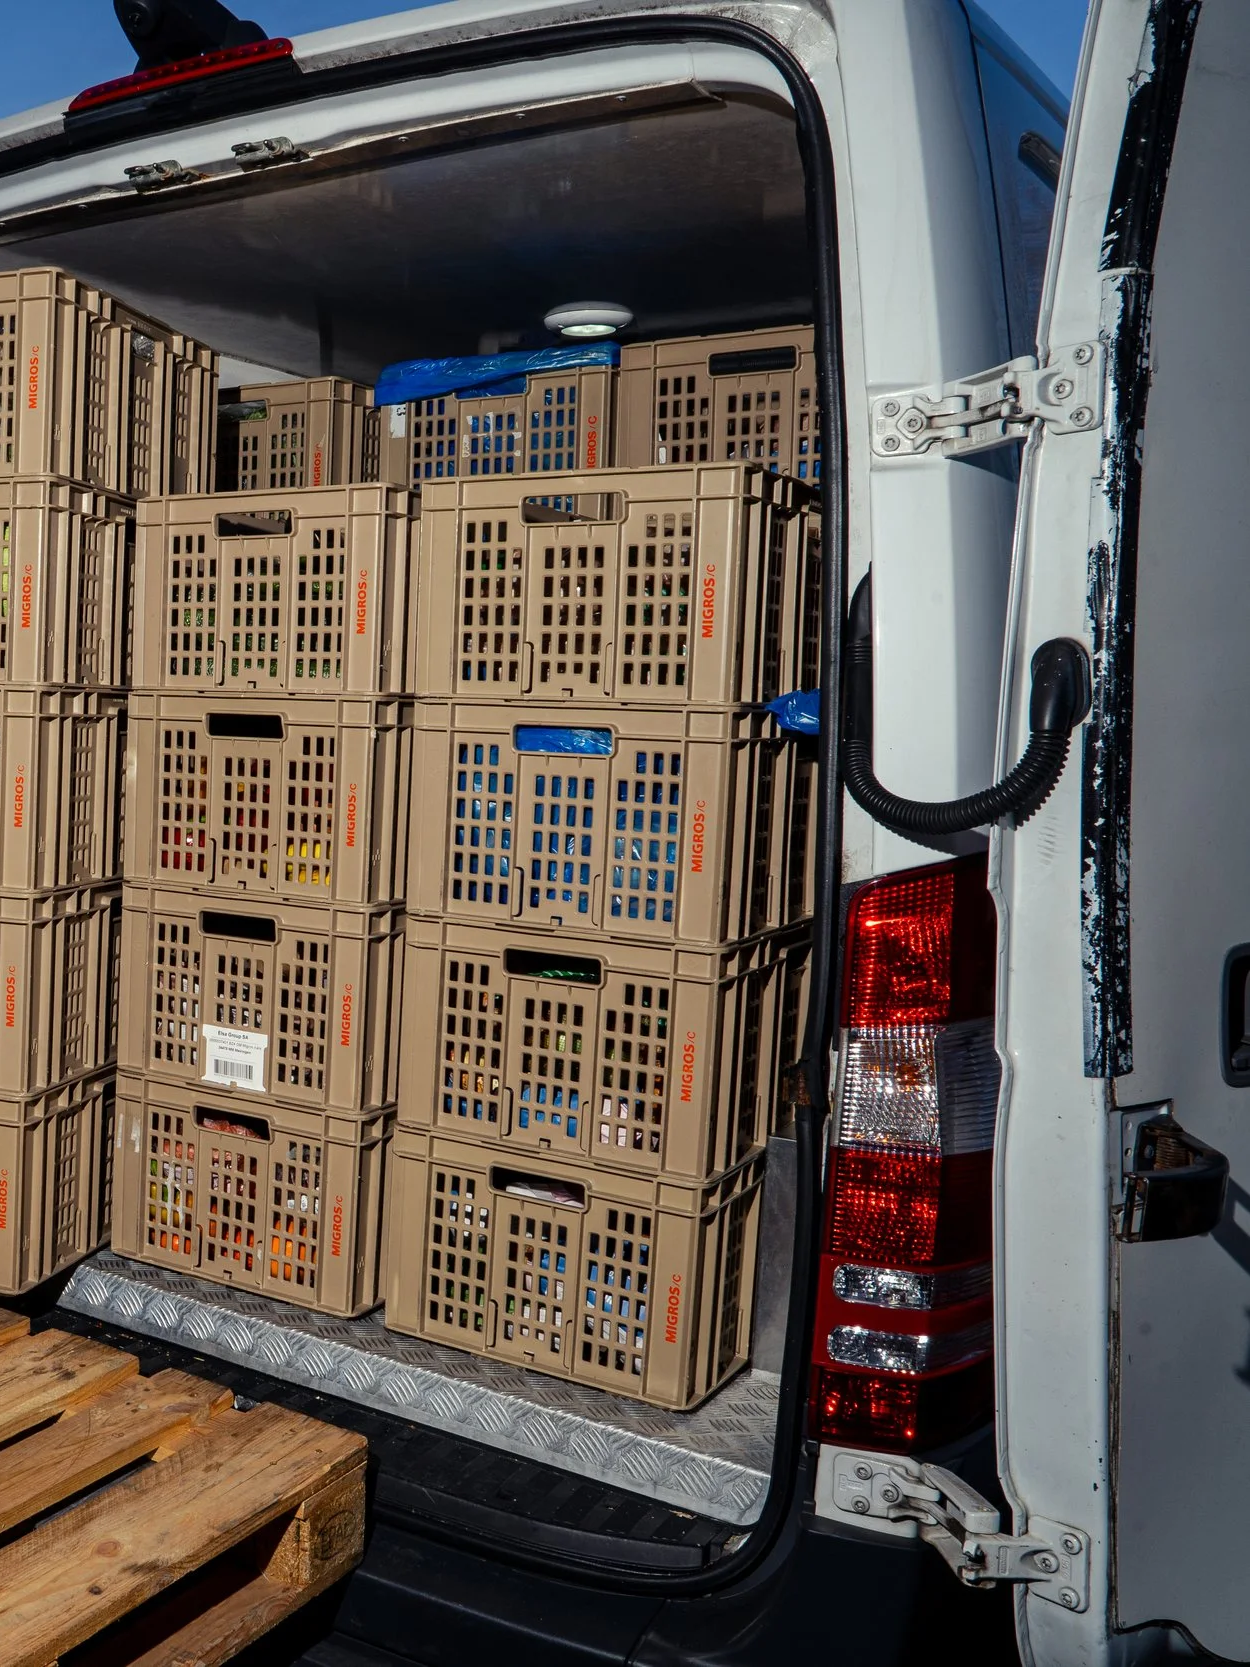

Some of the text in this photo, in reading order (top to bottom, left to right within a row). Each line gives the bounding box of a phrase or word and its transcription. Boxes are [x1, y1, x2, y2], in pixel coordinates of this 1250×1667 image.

[28, 345, 40, 409] MIGROS/C
[586, 415, 598, 469] IGROS/C
[21, 564, 33, 629] MIGROS/C
[355, 569, 368, 635] MIGROS/C
[701, 563, 717, 639] MIGROS/C
[13, 765, 25, 828] MIGROS/C
[345, 783, 357, 848] MIGROS/C
[690, 799, 707, 873] MIGROS/C
[5, 965, 16, 1028] MIGROS/C
[340, 983, 353, 1047] MIGROS/C
[679, 1031, 697, 1103] MIGROS/C
[330, 1195, 343, 1257] MIGROS/C
[664, 1274, 682, 1344] MIGROS/C
